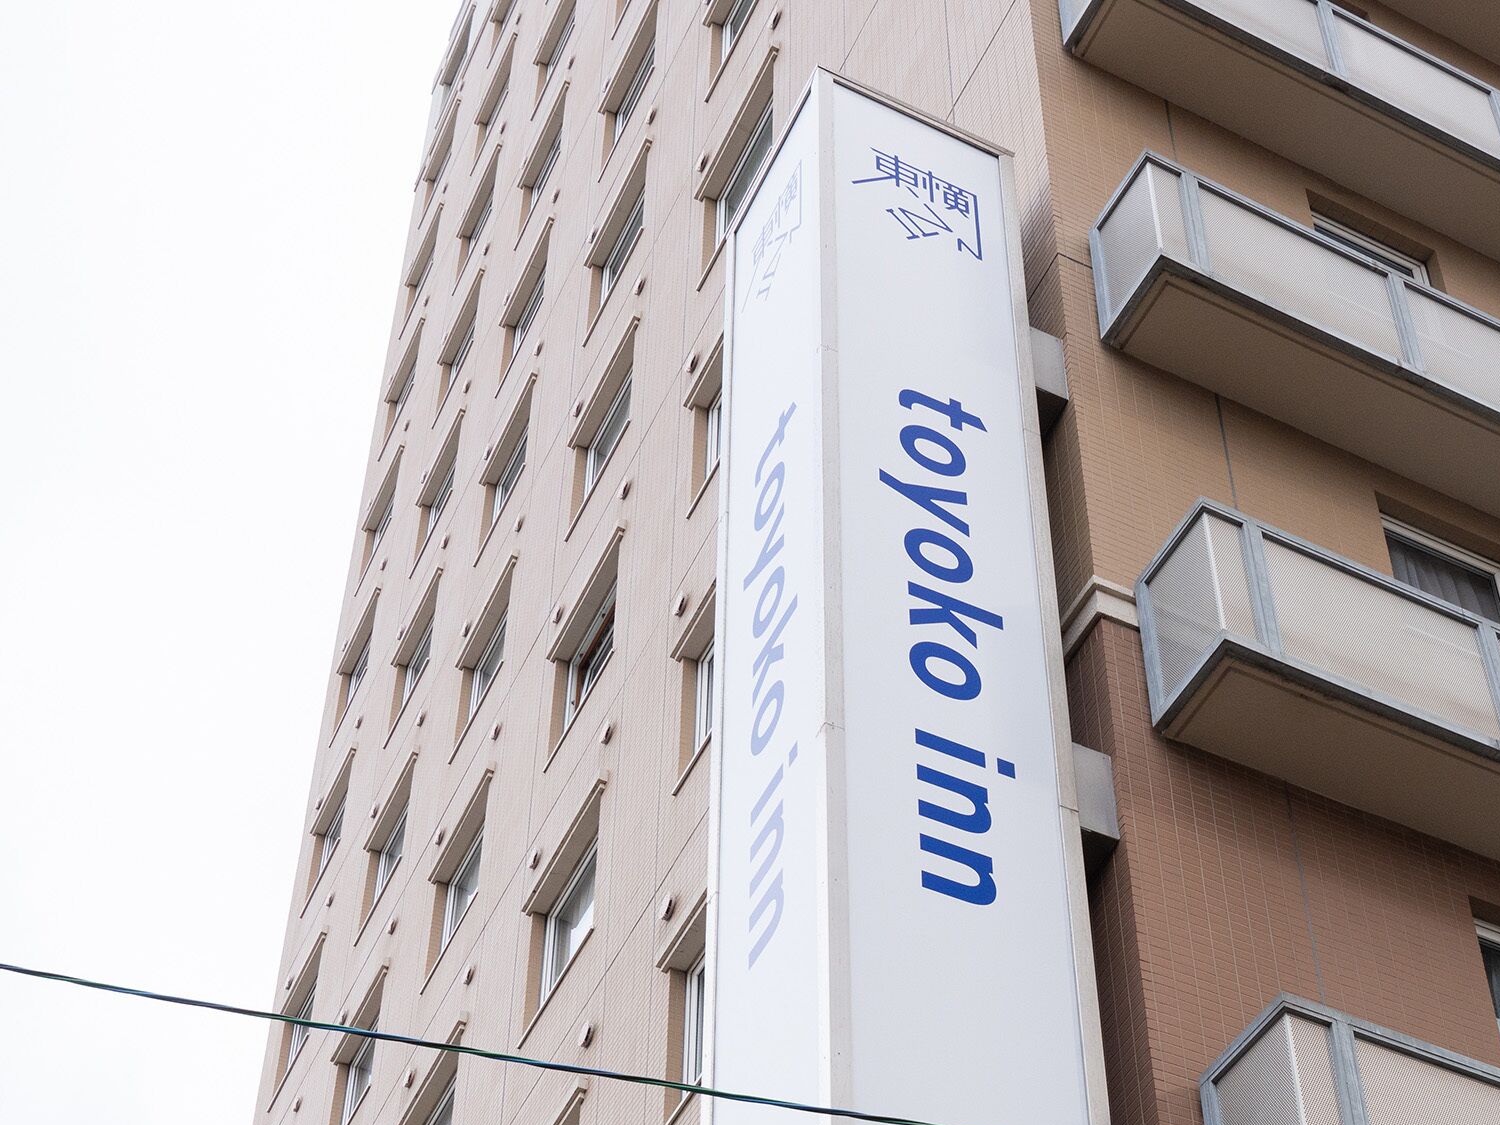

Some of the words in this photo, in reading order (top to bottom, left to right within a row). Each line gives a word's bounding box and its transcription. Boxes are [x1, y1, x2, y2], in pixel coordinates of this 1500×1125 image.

[743, 401, 798, 758] toyoko
[880, 388, 1004, 701] toyoko
[748, 750, 798, 970] inn
[915, 728, 1017, 906] inn
